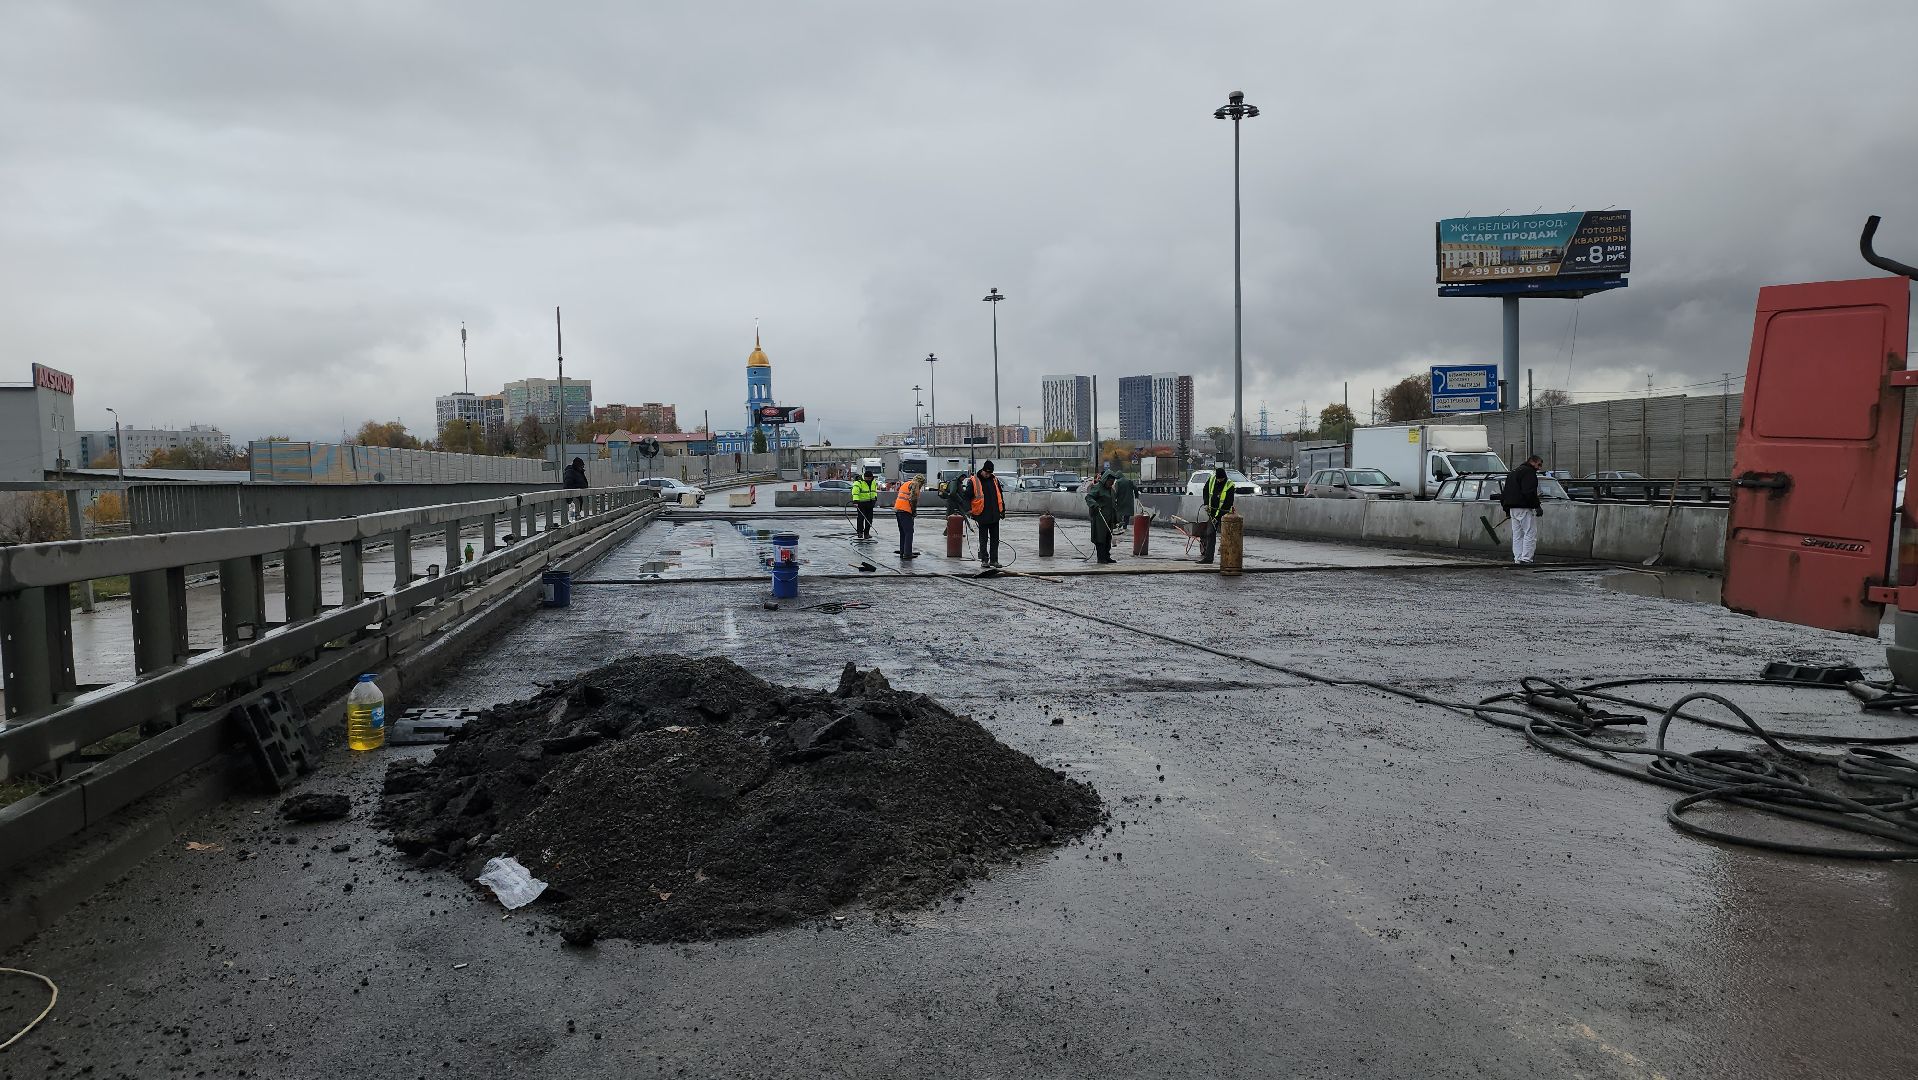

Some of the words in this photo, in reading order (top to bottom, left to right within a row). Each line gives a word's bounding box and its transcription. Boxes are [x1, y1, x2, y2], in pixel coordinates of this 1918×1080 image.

[1450, 223, 1469, 232] ЖК
[1472, 219, 1520, 231] «БЕЛЫЙ
[1523, 219, 1568, 230] ГОРОД»
[1582, 225, 1627, 234] ГОТОВЫЕ
[1461, 233, 1500, 242] СТАРТ
[1503, 230, 1558, 241] ПРОДАЖ
[1575, 235, 1627, 245] КВАРТИРЫ
[1589, 245, 1603, 264] 8
[1606, 251, 1627, 262] руб.
[1451, 268, 1465, 276] +7
[1468, 267, 1490, 275] 499
